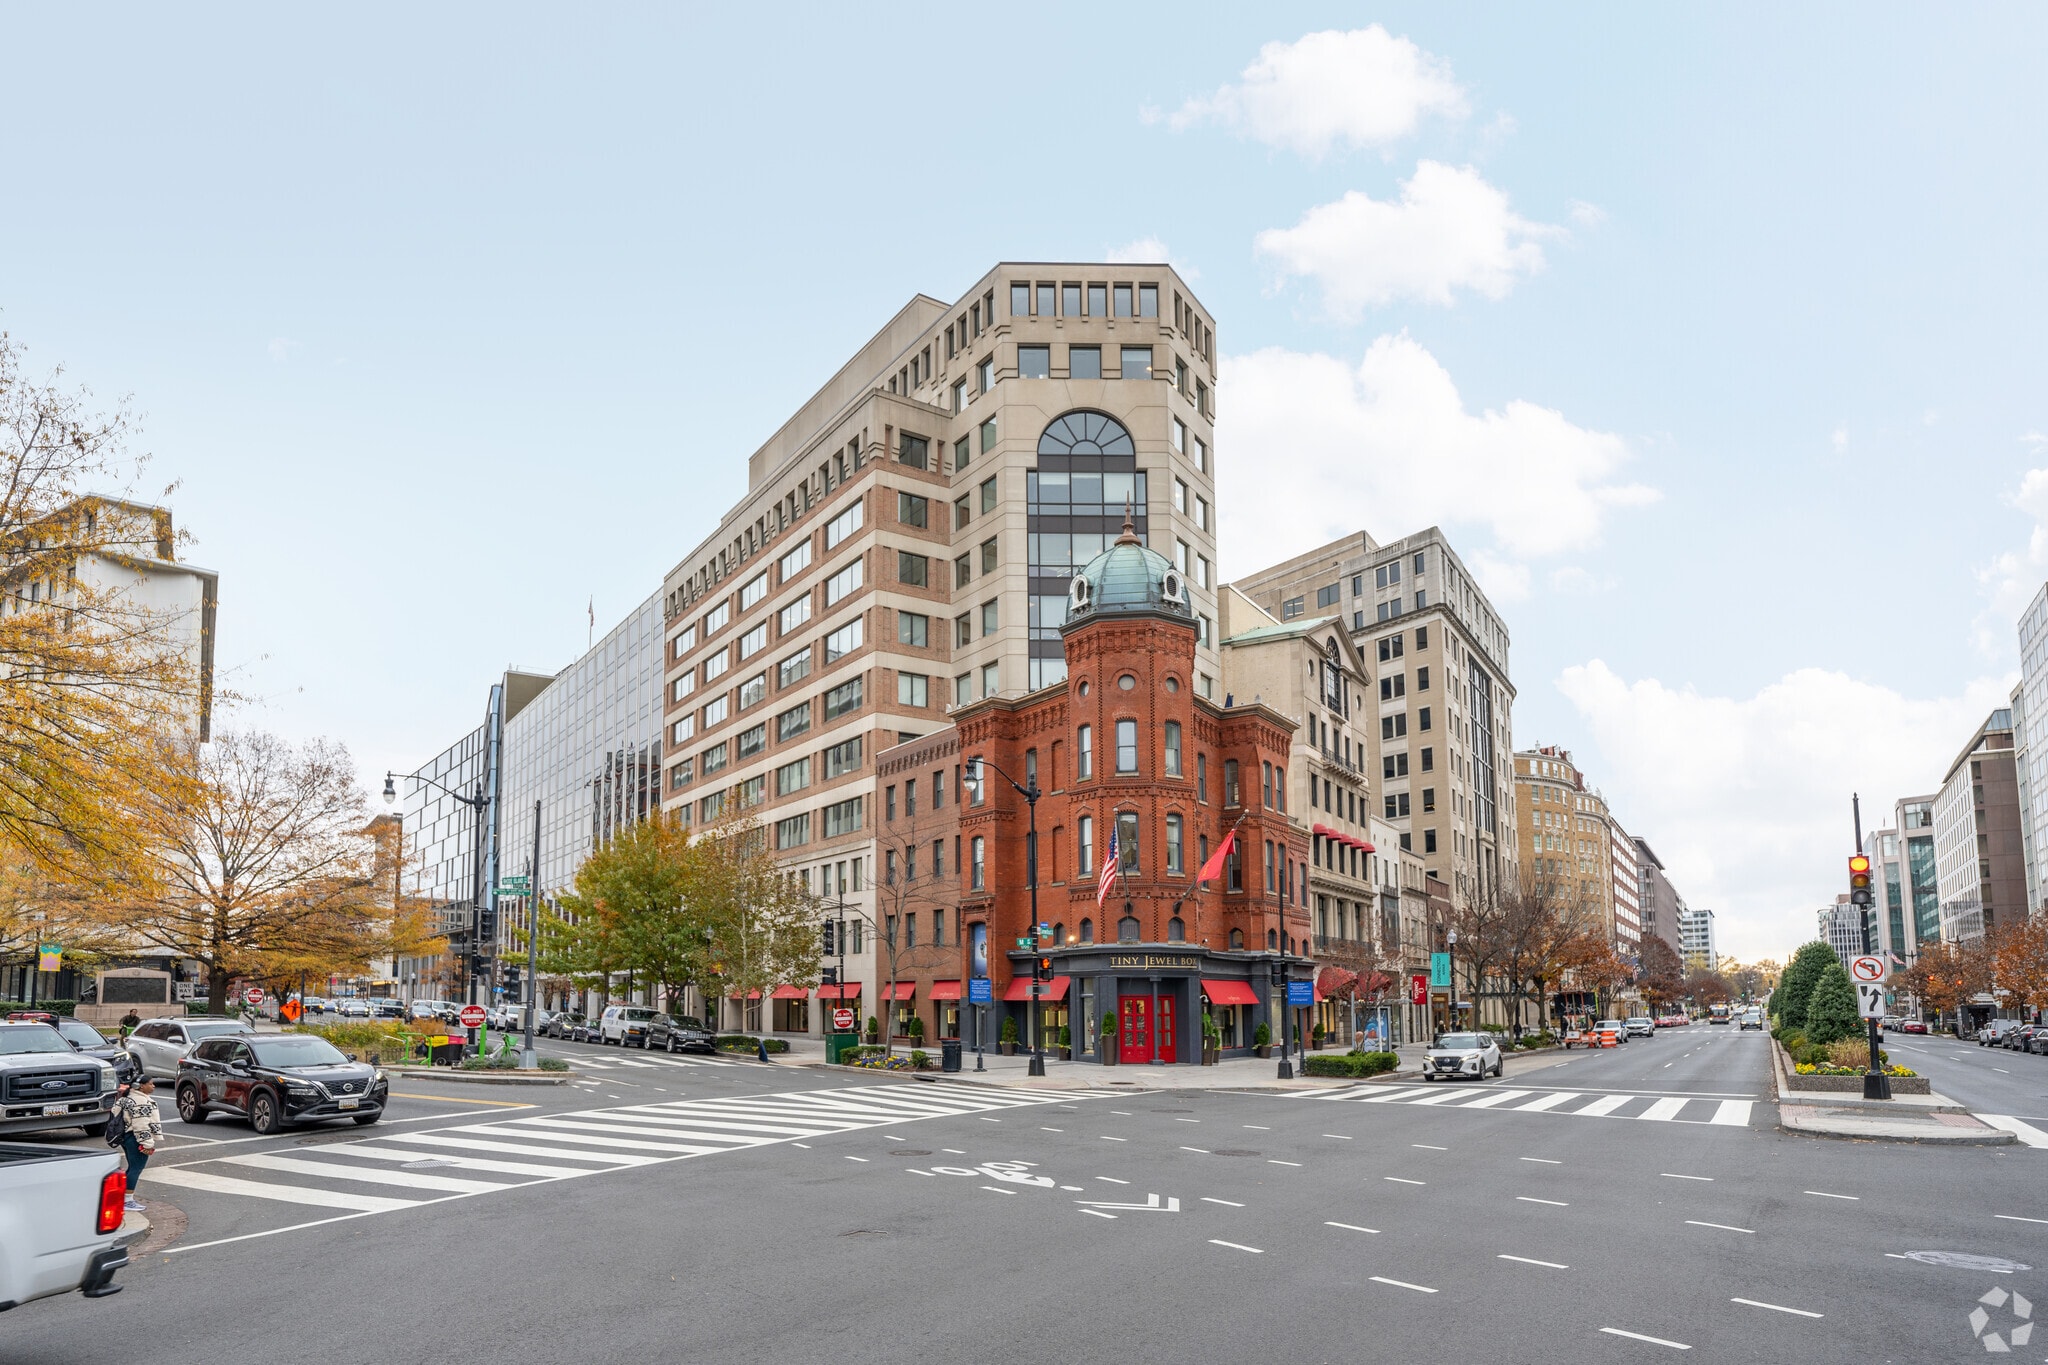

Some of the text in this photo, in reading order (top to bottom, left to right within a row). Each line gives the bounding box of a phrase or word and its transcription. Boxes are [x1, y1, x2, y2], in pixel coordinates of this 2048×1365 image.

[1110, 955, 1197, 970] TINY JEWEL BOX
